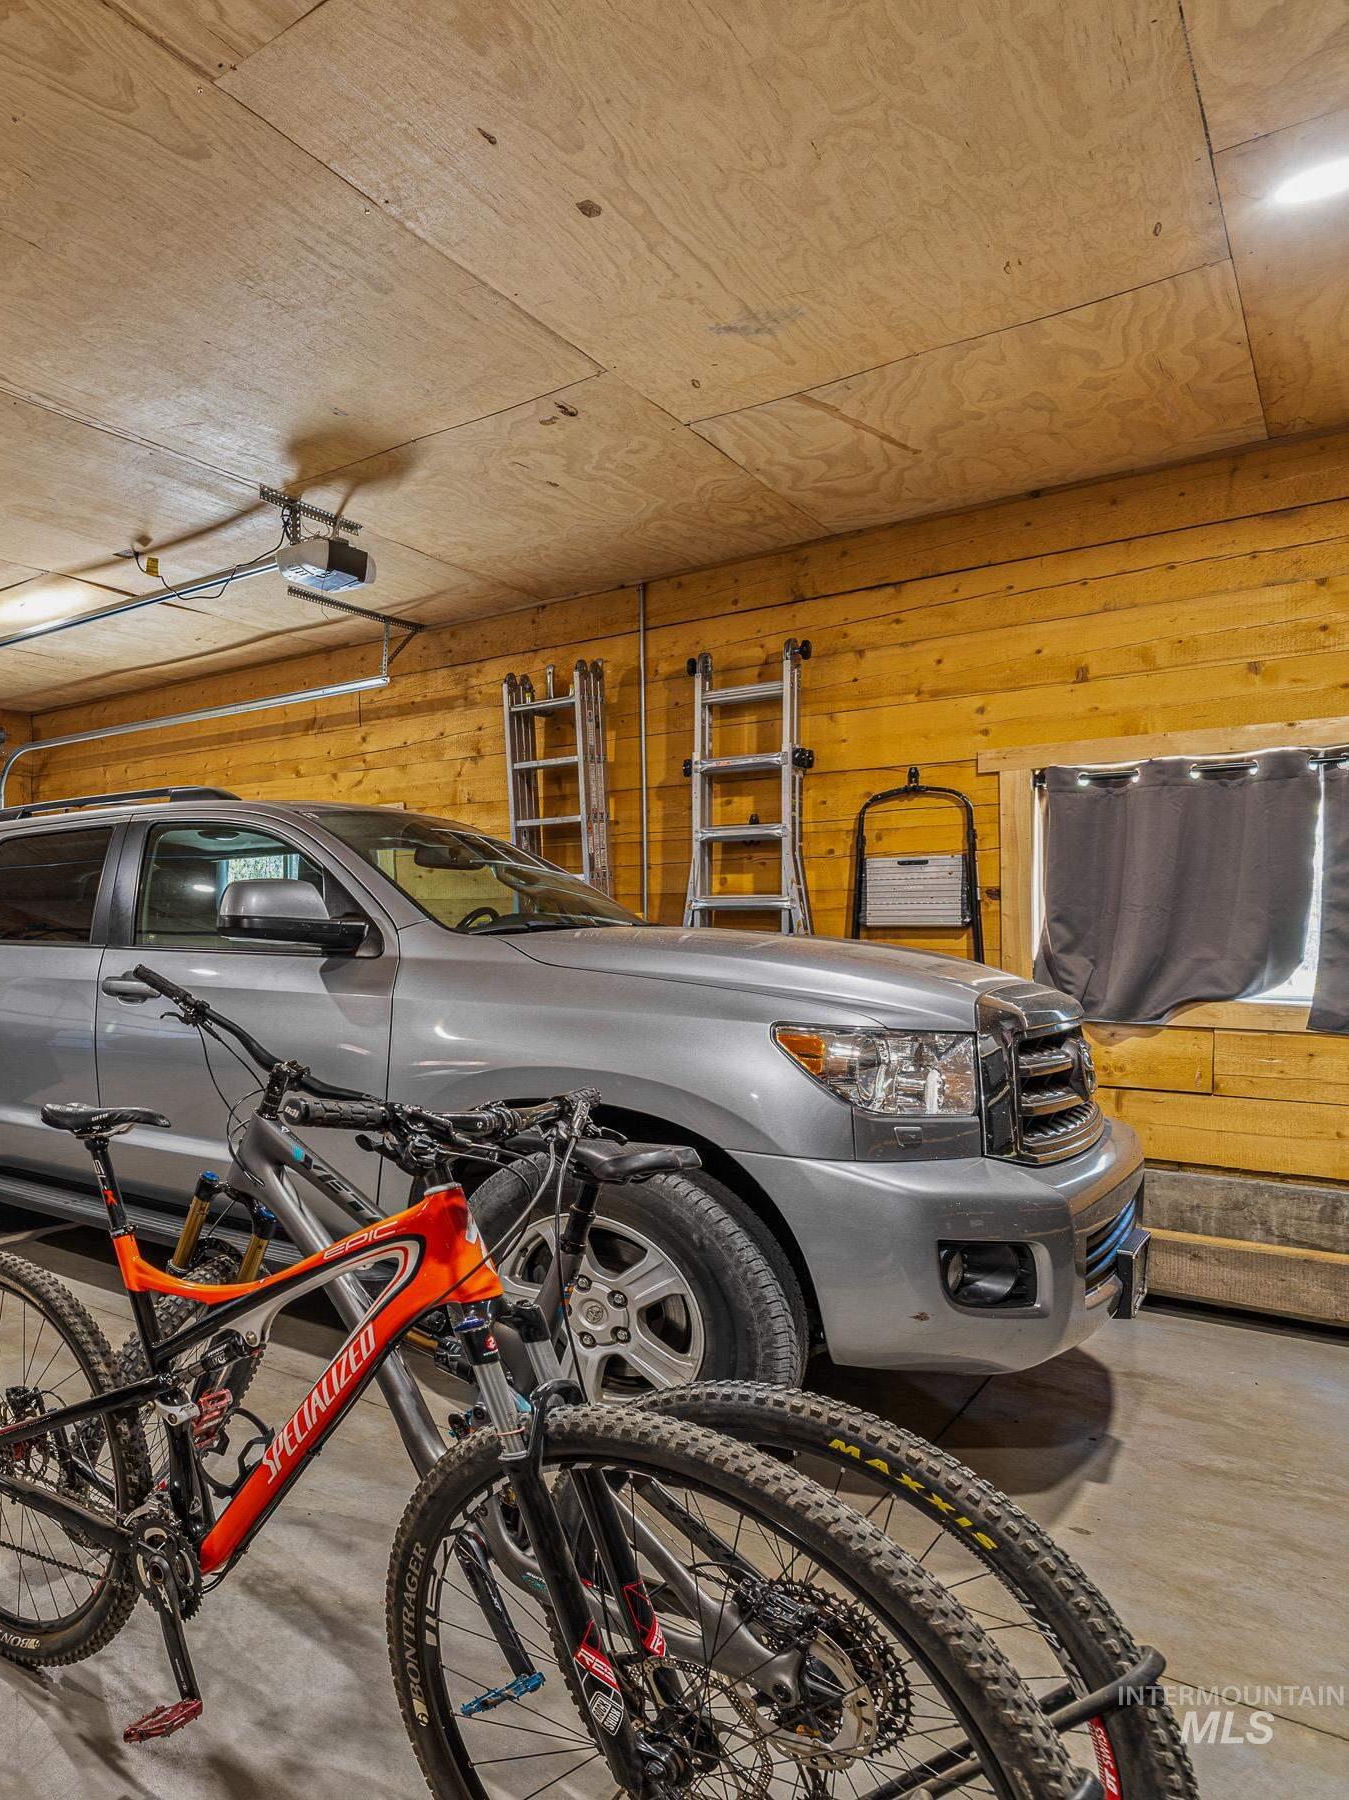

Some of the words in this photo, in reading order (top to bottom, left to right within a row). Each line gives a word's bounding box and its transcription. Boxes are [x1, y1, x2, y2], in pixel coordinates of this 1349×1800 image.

[322, 1220, 398, 1261] EPIC
[262, 1323, 376, 1485] SPECIALIZED
[828, 1438, 998, 1550] MAXXIS
[402, 1541, 427, 1702] BONTRAGER
